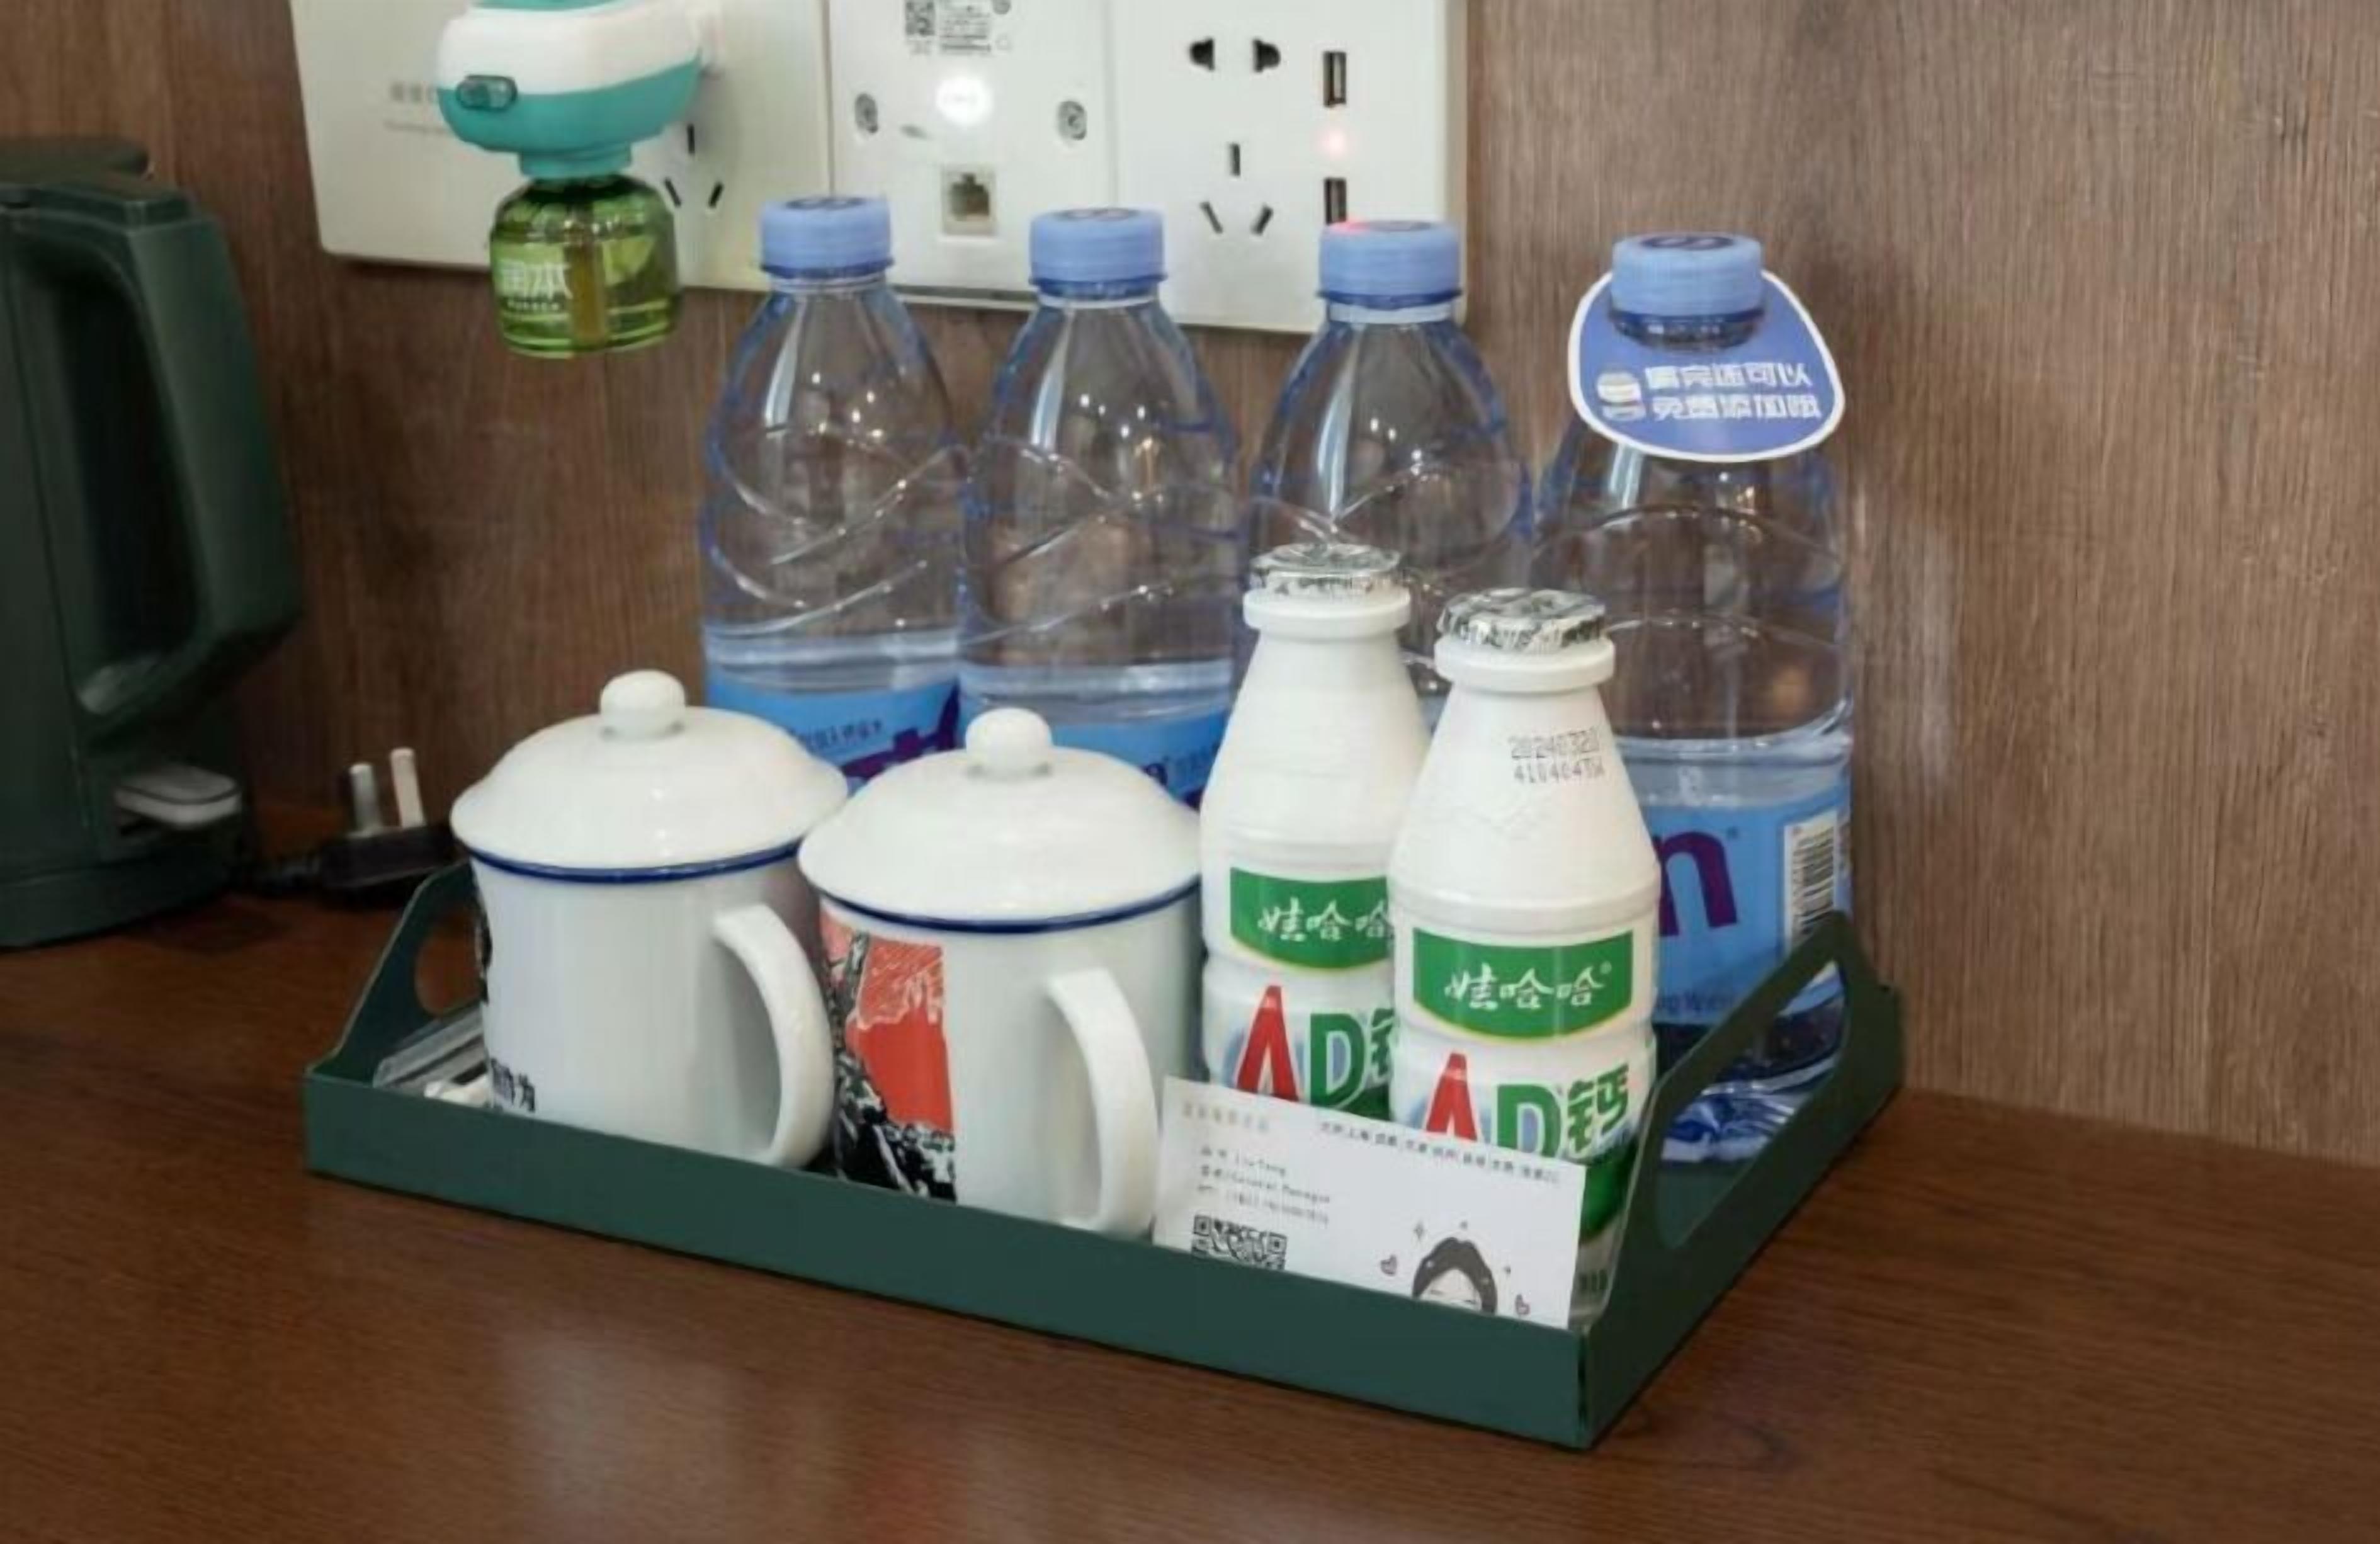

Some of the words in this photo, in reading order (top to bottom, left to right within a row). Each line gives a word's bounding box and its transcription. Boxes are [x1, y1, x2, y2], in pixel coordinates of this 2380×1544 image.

[1258, 896, 1395, 942] 娃哈哈
[1445, 962, 1606, 1010] 娃哈哈
